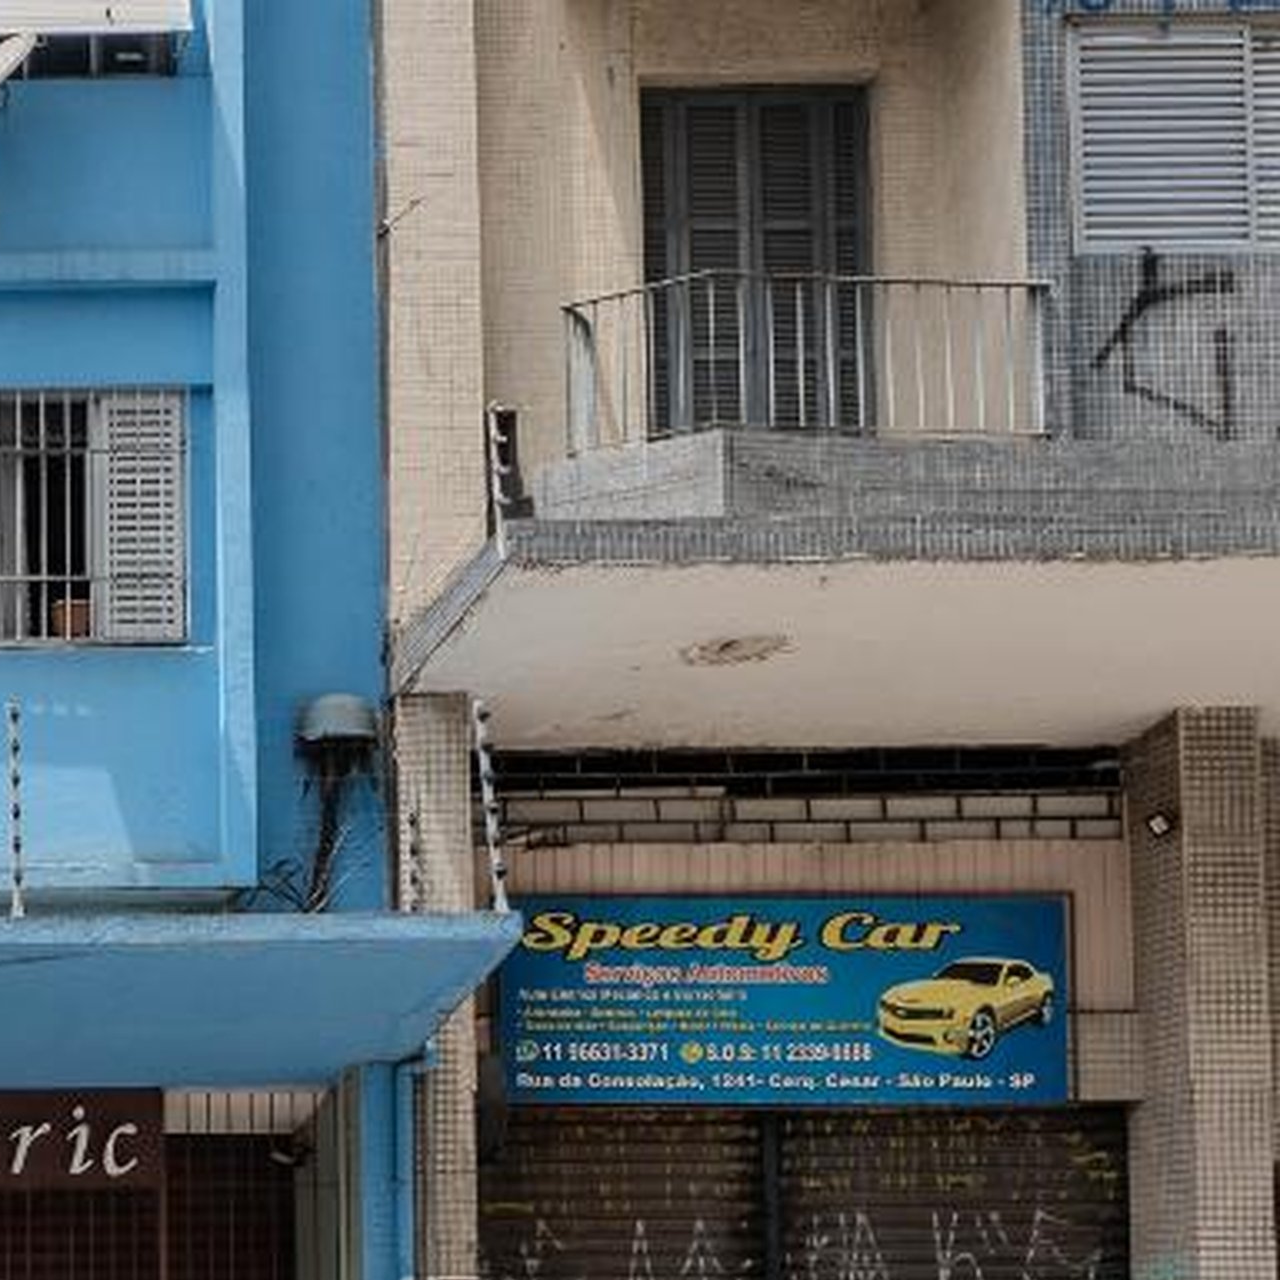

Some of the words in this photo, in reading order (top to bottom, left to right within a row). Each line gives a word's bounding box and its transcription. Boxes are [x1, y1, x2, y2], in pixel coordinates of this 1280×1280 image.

[521, 911, 803, 962] Speedy
[822, 911, 962, 951] Car
[515, 1073, 555, 1088] Rua
[558, 1072, 583, 1088] da
[896, 1071, 935, 1088] São
[938, 1073, 993, 1088] Paulo
[1008, 1073, 1036, 1088] SP
